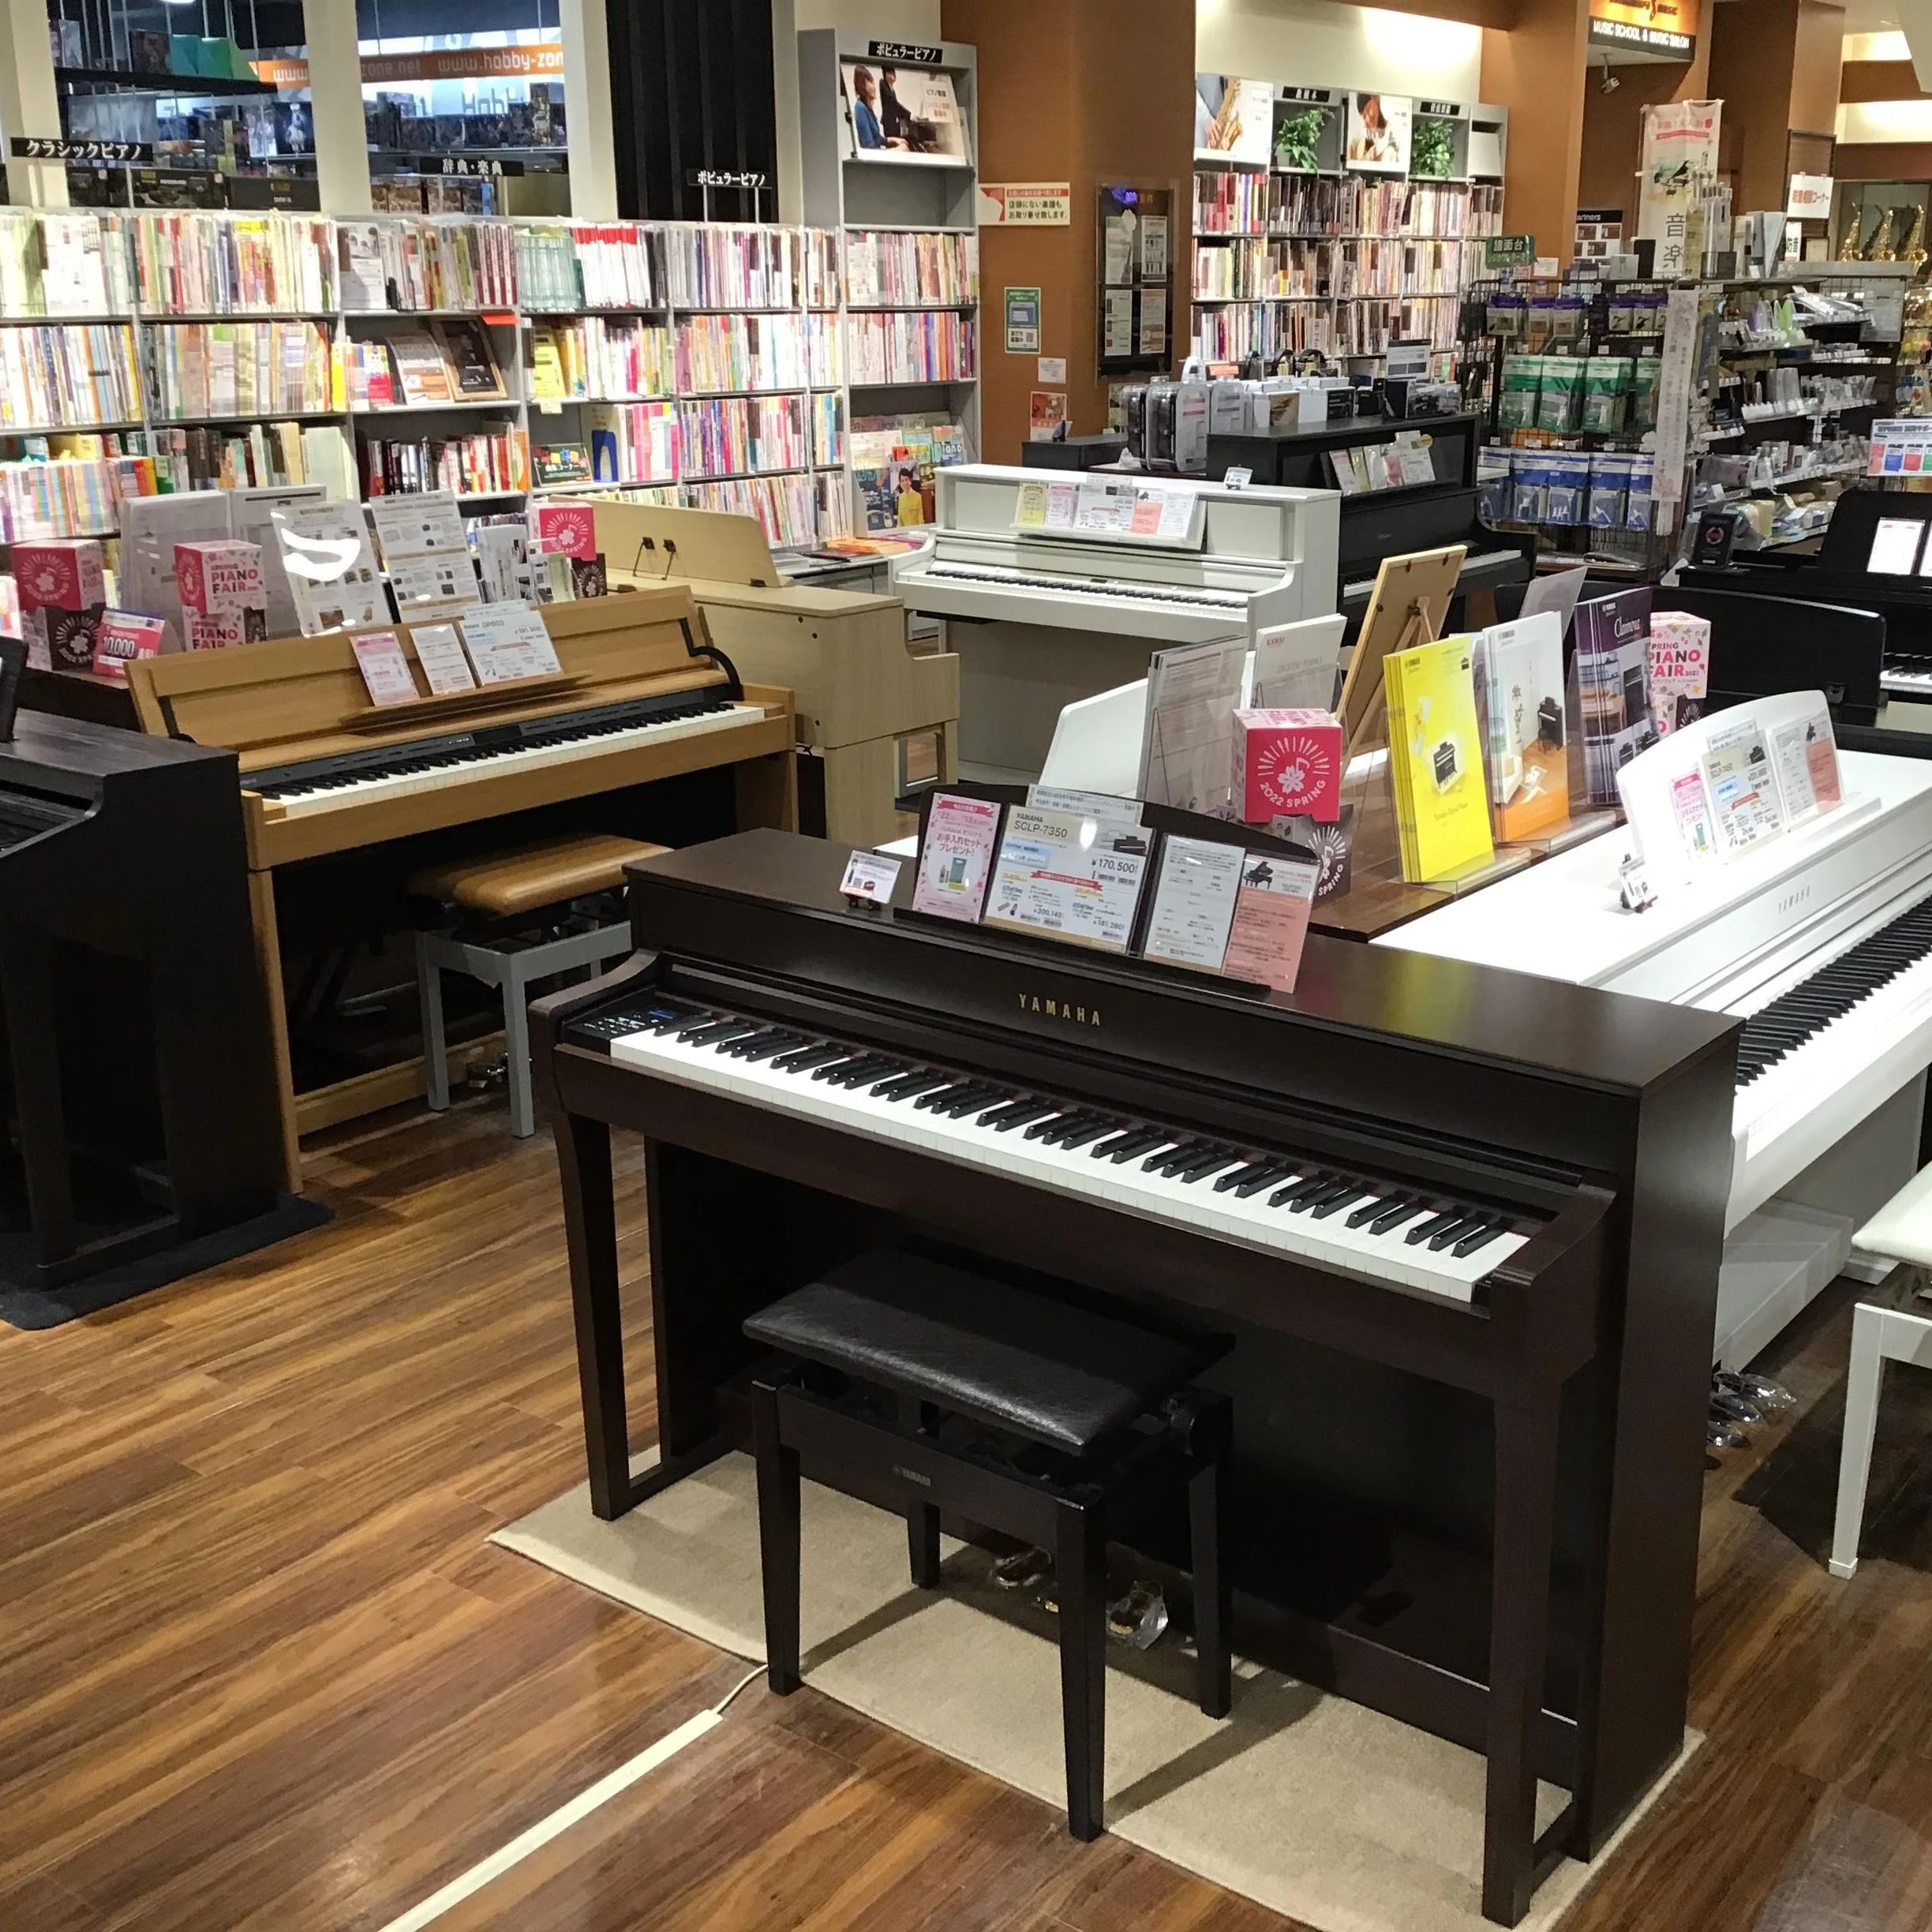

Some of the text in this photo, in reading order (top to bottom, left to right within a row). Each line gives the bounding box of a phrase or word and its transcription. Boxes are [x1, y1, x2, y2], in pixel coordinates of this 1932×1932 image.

[1593, 20, 1615, 36] MUSIC
[1615, 24, 1641, 41] SCHOOL
[1649, 30, 1669, 46] MUSIC
[876, 43, 937, 61] ポピュラーピアノ
[26, 139, 142, 159] クラシックピアノ
[442, 157, 504, 176] 辞典・楽典
[697, 170, 766, 186] ポピュラーピアノ
[211, 568, 258, 582] PIANO
[212, 581, 247, 594] FAIR
[191, 627, 238, 640] PIANO
[1649, 642, 1679, 650] PRING
[1260, 778, 1326, 808] 2022 SPRING
[1016, 812, 1043, 823] YAMAHA
[1013, 819, 1068, 839] SCLP-7350
[936, 833, 983, 848] お手入れセット
[1318, 863, 1344, 897] SPRING
[1018, 993, 1100, 1026] YAMAHA
